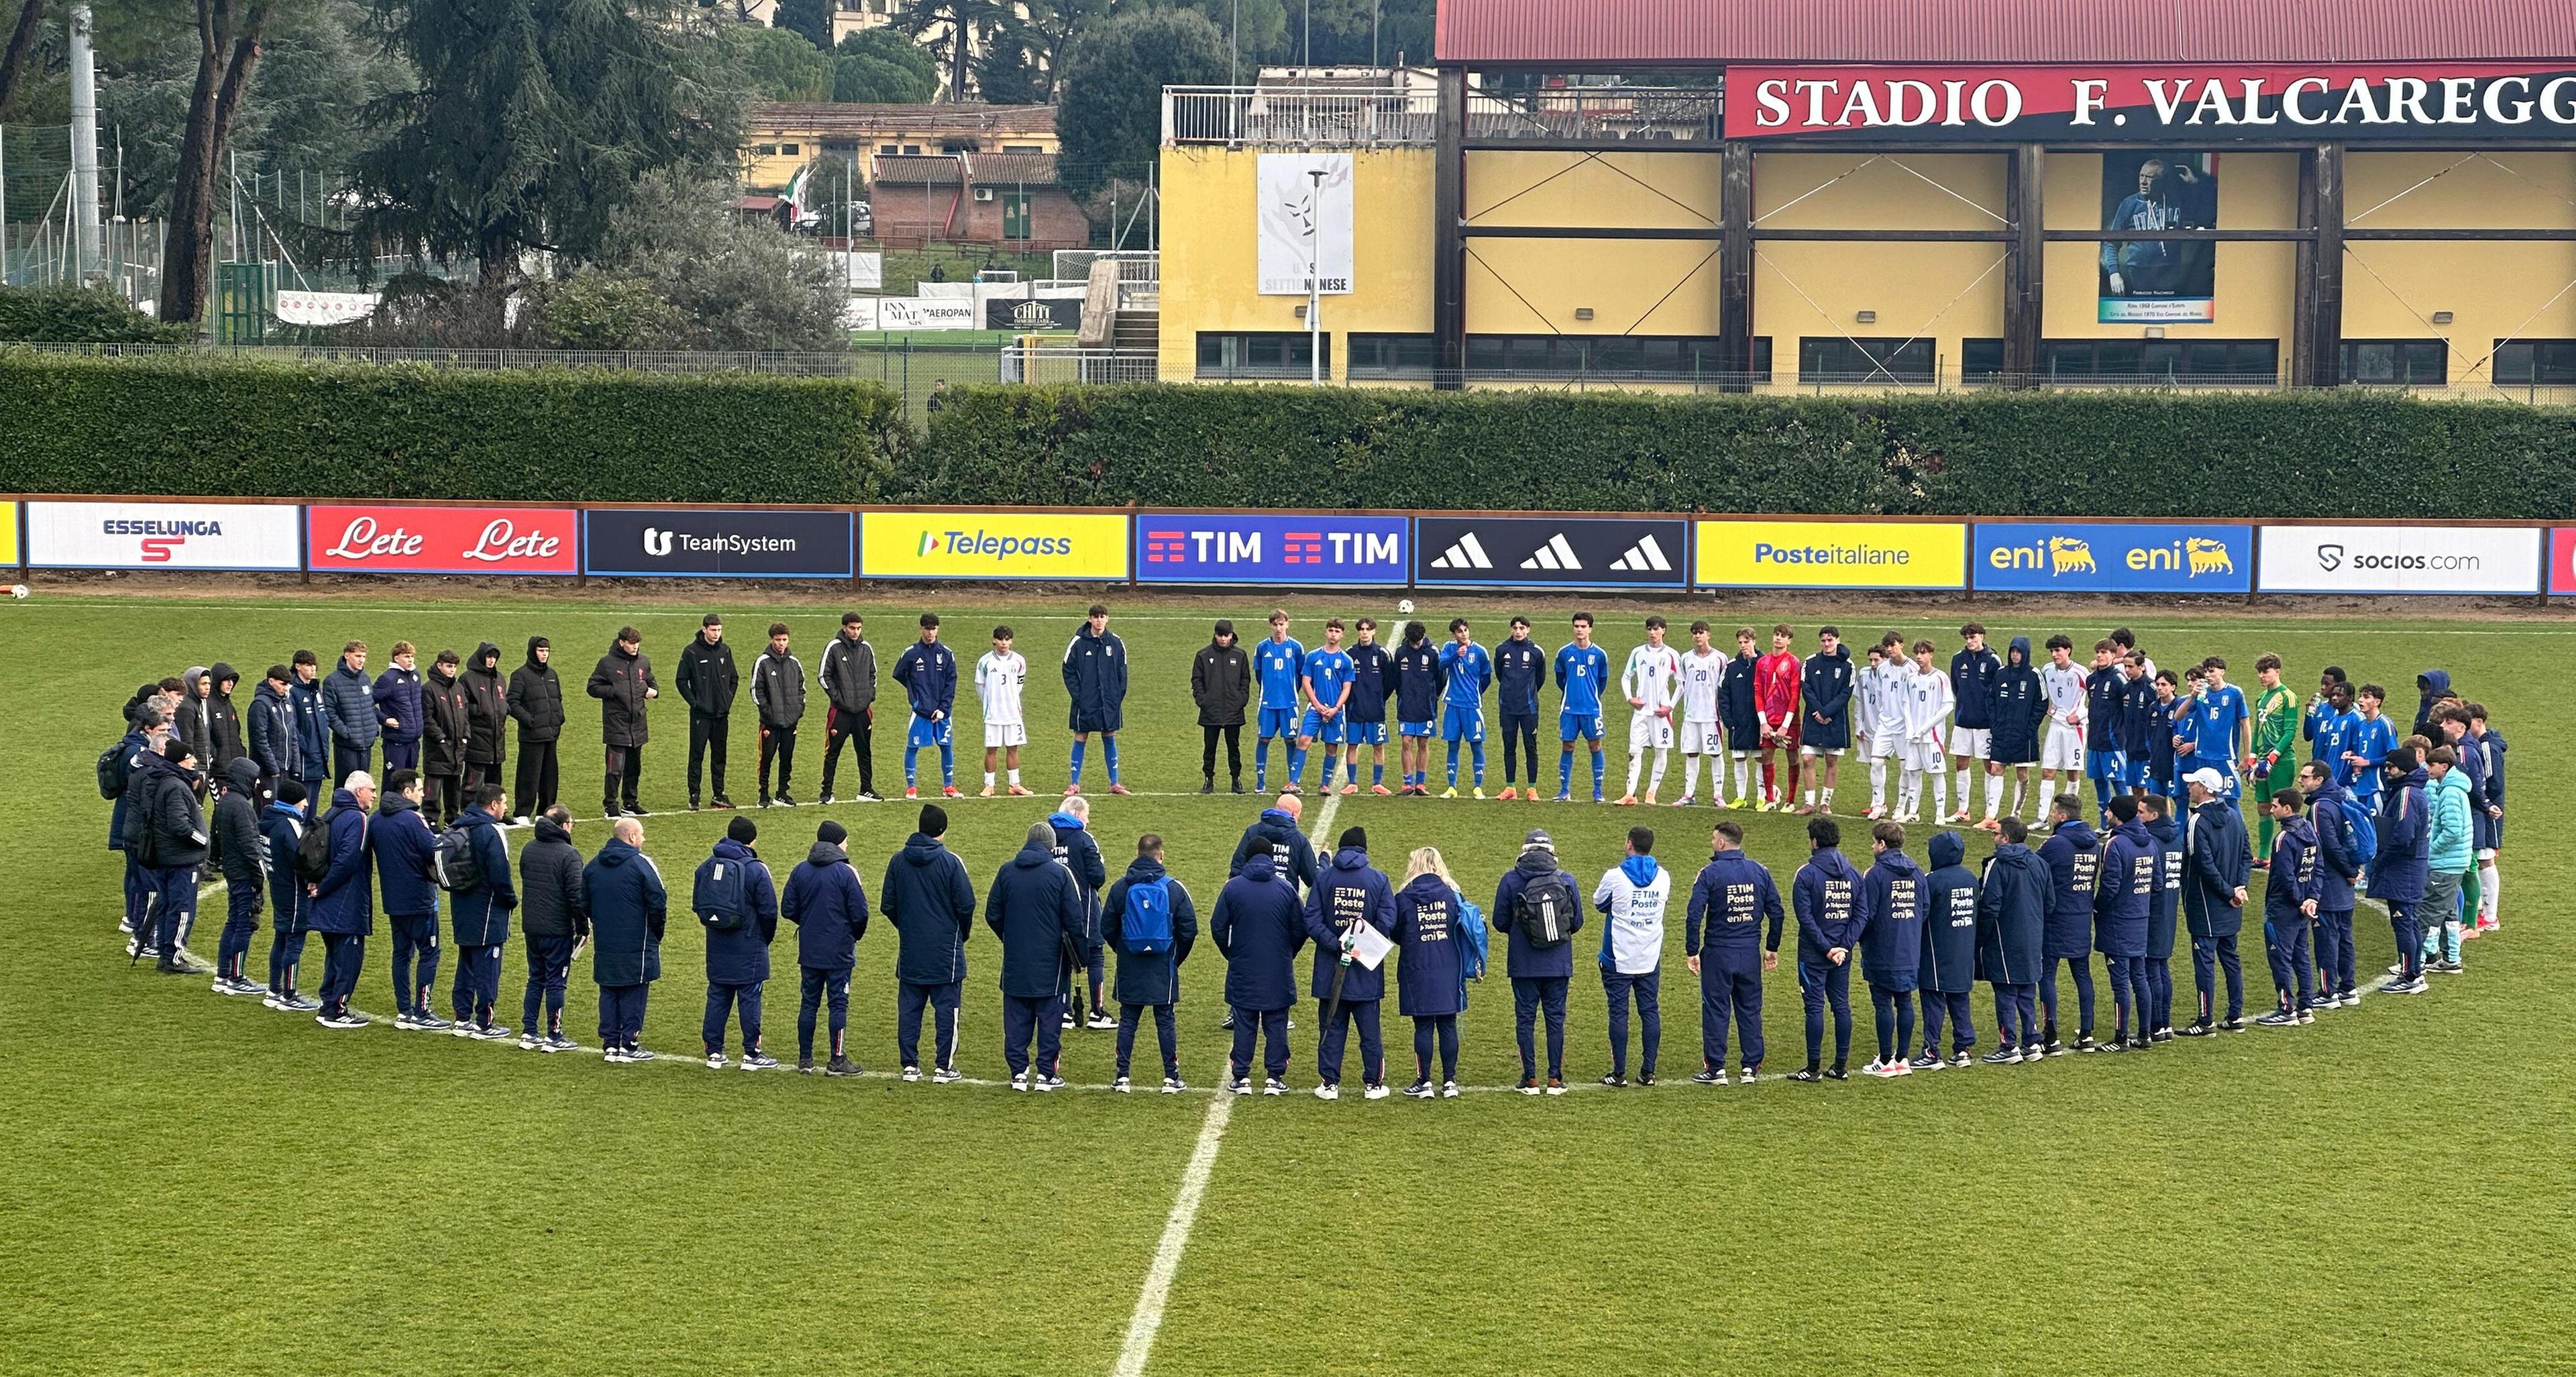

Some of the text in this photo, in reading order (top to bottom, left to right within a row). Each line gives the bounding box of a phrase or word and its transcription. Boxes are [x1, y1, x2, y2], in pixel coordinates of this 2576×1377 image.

[1756, 76, 2576, 126] STADIO F. VALCAREGG
[1265, 278, 1346, 290] SETTIGNNESE
[885, 302, 906, 311] INN
[891, 311, 918, 320] MAT
[928, 309, 971, 318] AEROPAN
[103, 519, 221, 536] ESSELUNGA
[325, 516, 560, 561] Lete Lete
[679, 533, 796, 555] TeamSystem
[944, 530, 1071, 560] Telepass
[1191, 531, 1398, 565] TIM TIM
[1755, 543, 1910, 566] Posteitaliane
[1990, 539, 2180, 571] eni eni
[2353, 555, 2479, 571] socios.com
[1274, 657, 1283, 670] 10
[1324, 667, 1332, 680] 9
[1576, 664, 1585, 677] 15
[1649, 666, 1655, 677] 8
[1695, 669, 1706, 681] 20
[1001, 674, 1006, 685] 3
[2057, 686, 2063, 698] 6
[2209, 707, 2218, 720] 16
[1290, 717, 1298, 729] 10
[1595, 716, 1604, 730] 15
[2187, 718, 2193, 730] 7
[944, 725, 951, 737] 2
[1017, 724, 1022, 736] 3
[1377, 724, 1387, 736] 21
[1662, 728, 1668, 739] 8
[1707, 734, 1718, 745] 20
[2362, 740, 2368, 753] 3
[1932, 751, 1941, 763] 10
[2074, 749, 2080, 760] 6
[2110, 759, 2118, 771] 4
[2143, 766, 2151, 778] 5
[2223, 776, 2234, 789] 16
[1055, 846, 1068, 856] TIM
[1273, 843, 1290, 854] TIM
[2084, 854, 2097, 863] TIM
[2142, 855, 2153, 865] TIM
[2074, 863, 2094, 872] Poste
[2135, 867, 2153, 875] Poste
[1738, 883, 1754, 893] TIM
[1835, 881, 1851, 890] TIM
[1900, 880, 1915, 889] TIM
[2072, 881, 2086, 891] eni
[1346, 888, 1366, 898] TIM
[1643, 891, 1659, 899] TIM
[1825, 890, 1851, 899] Poste
[1891, 890, 1915, 899] Poste
[1960, 887, 1973, 897] TIM
[1334, 896, 1364, 908] Poste
[1631, 899, 1658, 907] Poste
[1727, 894, 1754, 904] Poste
[1951, 897, 1974, 907] Poste
[1417, 912, 1447, 922] Poste
[1727, 914, 1742, 923] eni
[1825, 911, 1840, 920] eni
[1892, 910, 1905, 919] eni
[1335, 918, 1349, 927] eni
[1951, 918, 1964, 927] eni
[1420, 932, 1436, 942] eni
